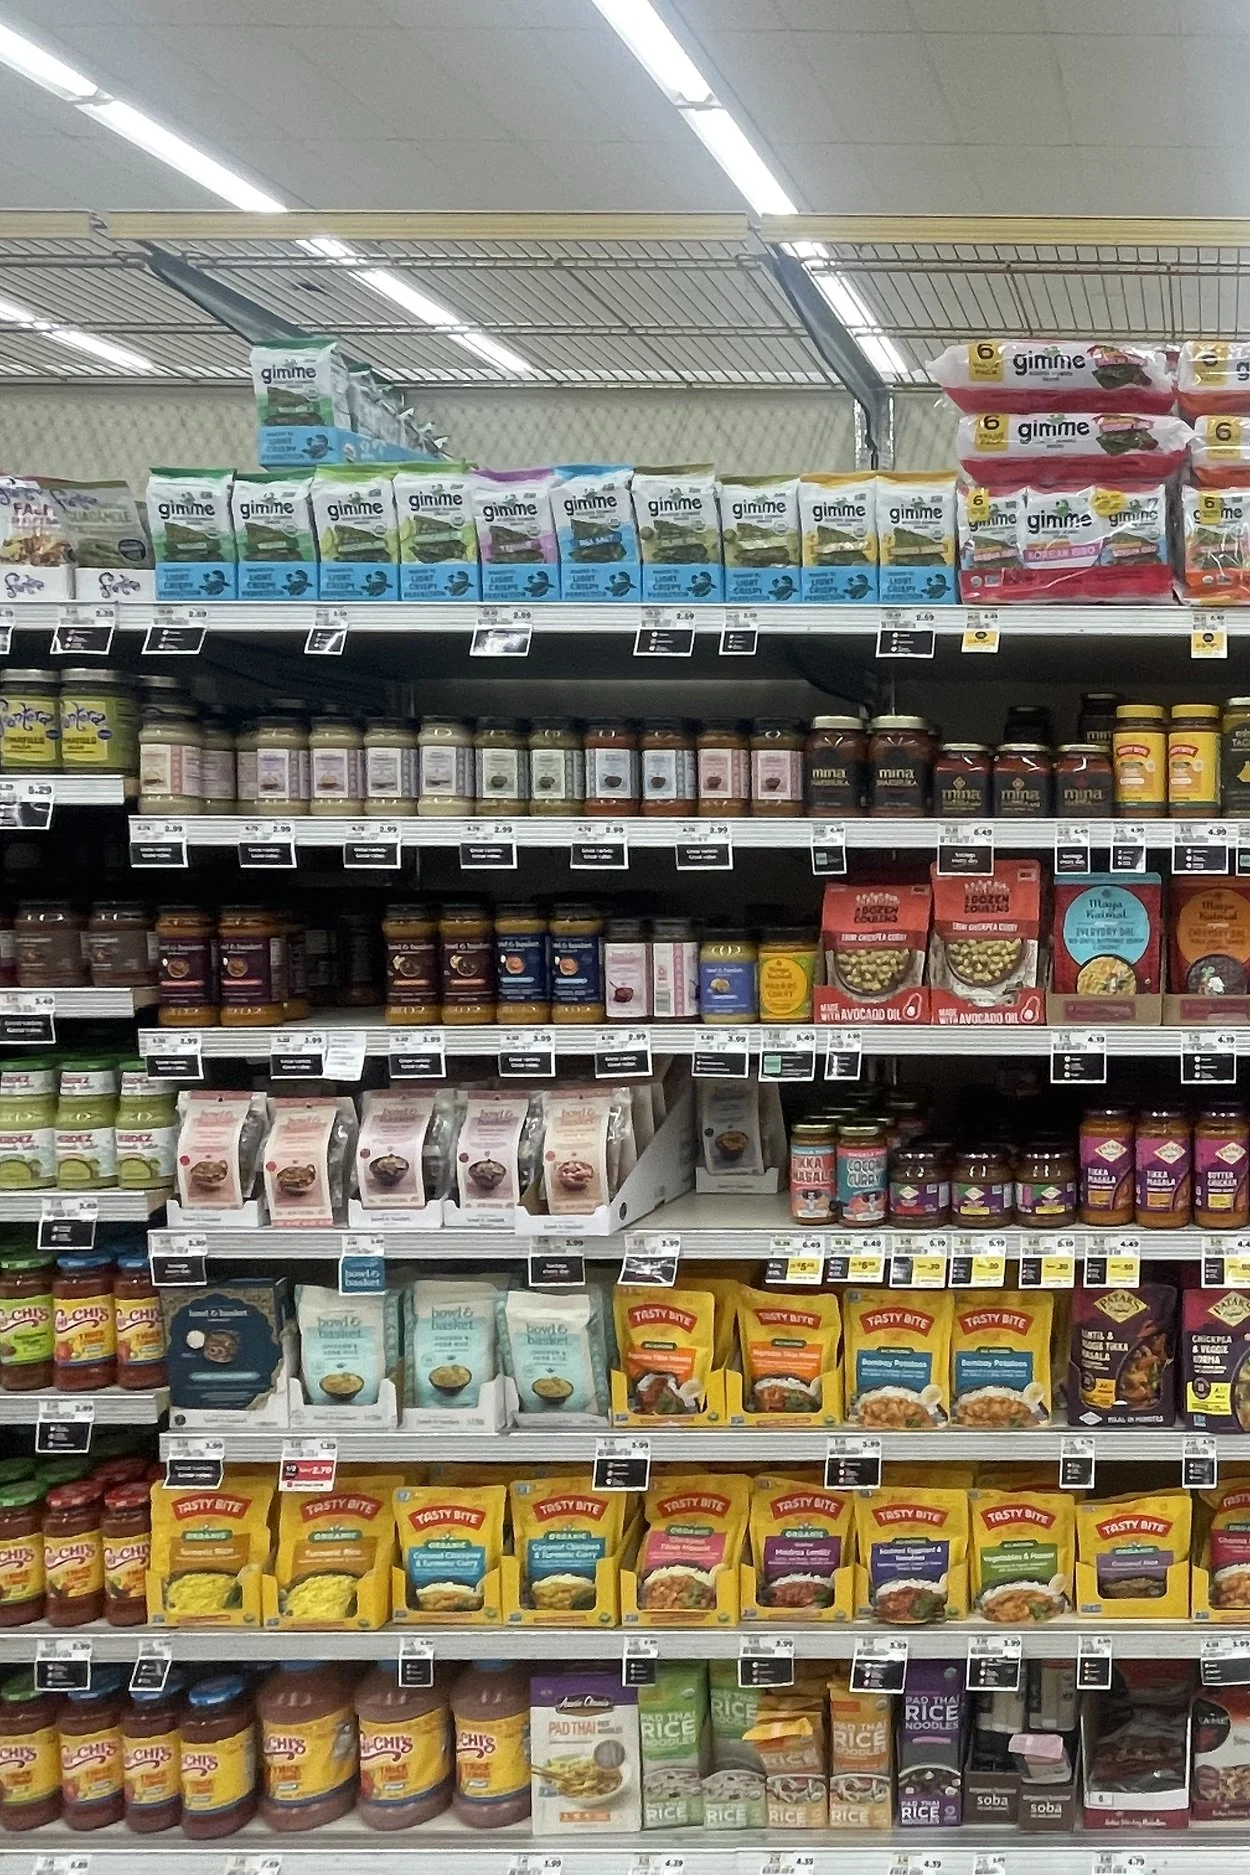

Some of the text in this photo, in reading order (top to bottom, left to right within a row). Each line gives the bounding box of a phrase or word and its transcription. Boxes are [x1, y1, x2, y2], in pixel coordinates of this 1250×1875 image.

[977, 344, 994, 359] 6
[1014, 352, 1086, 377] gimme
[262, 363, 316, 384] gimme
[984, 416, 1000, 430] 6
[1018, 419, 1090, 444] gimme
[1215, 423, 1232, 441] 6
[409, 489, 463, 512] gimme
[564, 494, 617, 516] gimme
[648, 495, 702, 516] gimme
[159, 499, 215, 520] gimme
[240, 499, 294, 520] gimme
[328, 499, 383, 520] gimme
[483, 501, 537, 522] gimme
[733, 499, 787, 520] gimme
[812, 502, 866, 521] gimme
[890, 504, 942, 523] gimme
[1028, 510, 1092, 534] gimme
[879, 769, 913, 779] mina
[942, 789, 981, 800] mina
[1002, 790, 1040, 801] mina
[842, 1008, 901, 1020] AVOCADO OIL
[959, 1012, 1019, 1024] AVOCADO OIL
[431, 1307, 460, 1318] bowl
[634, 1309, 691, 1326] TASTY BITE
[318, 1316, 346, 1327] bowl
[867, 1314, 929, 1328] TASTY BITE
[965, 1314, 1026, 1328] TASTY BITE
[178, 1499, 243, 1513] TASTY BITE
[306, 1501, 374, 1514] TASTY BITE
[540, 1500, 600, 1515] TASTY BITE
[664, 1497, 724, 1512] TASTY BITE
[777, 1497, 838, 1513] TASTY BITE
[416, 1510, 478, 1524] TASTY BITE
[988, 1509, 1049, 1524] TASTY BITE
[1103, 1521, 1166, 1534] TASTY BITE
[905, 1695, 959, 1704] PAD THAI
[905, 1705, 959, 1721] RICE
[641, 1722, 697, 1738] RICE
[905, 1721, 959, 1730] NOODLES
[977, 1794, 1009, 1807] soba
[646, 1805, 687, 1820] RICE
[706, 1809, 745, 1823] RICE
[902, 1807, 940, 1820] RICE
[1030, 1803, 1061, 1814] soba
[769, 1811, 806, 1823] RICE
